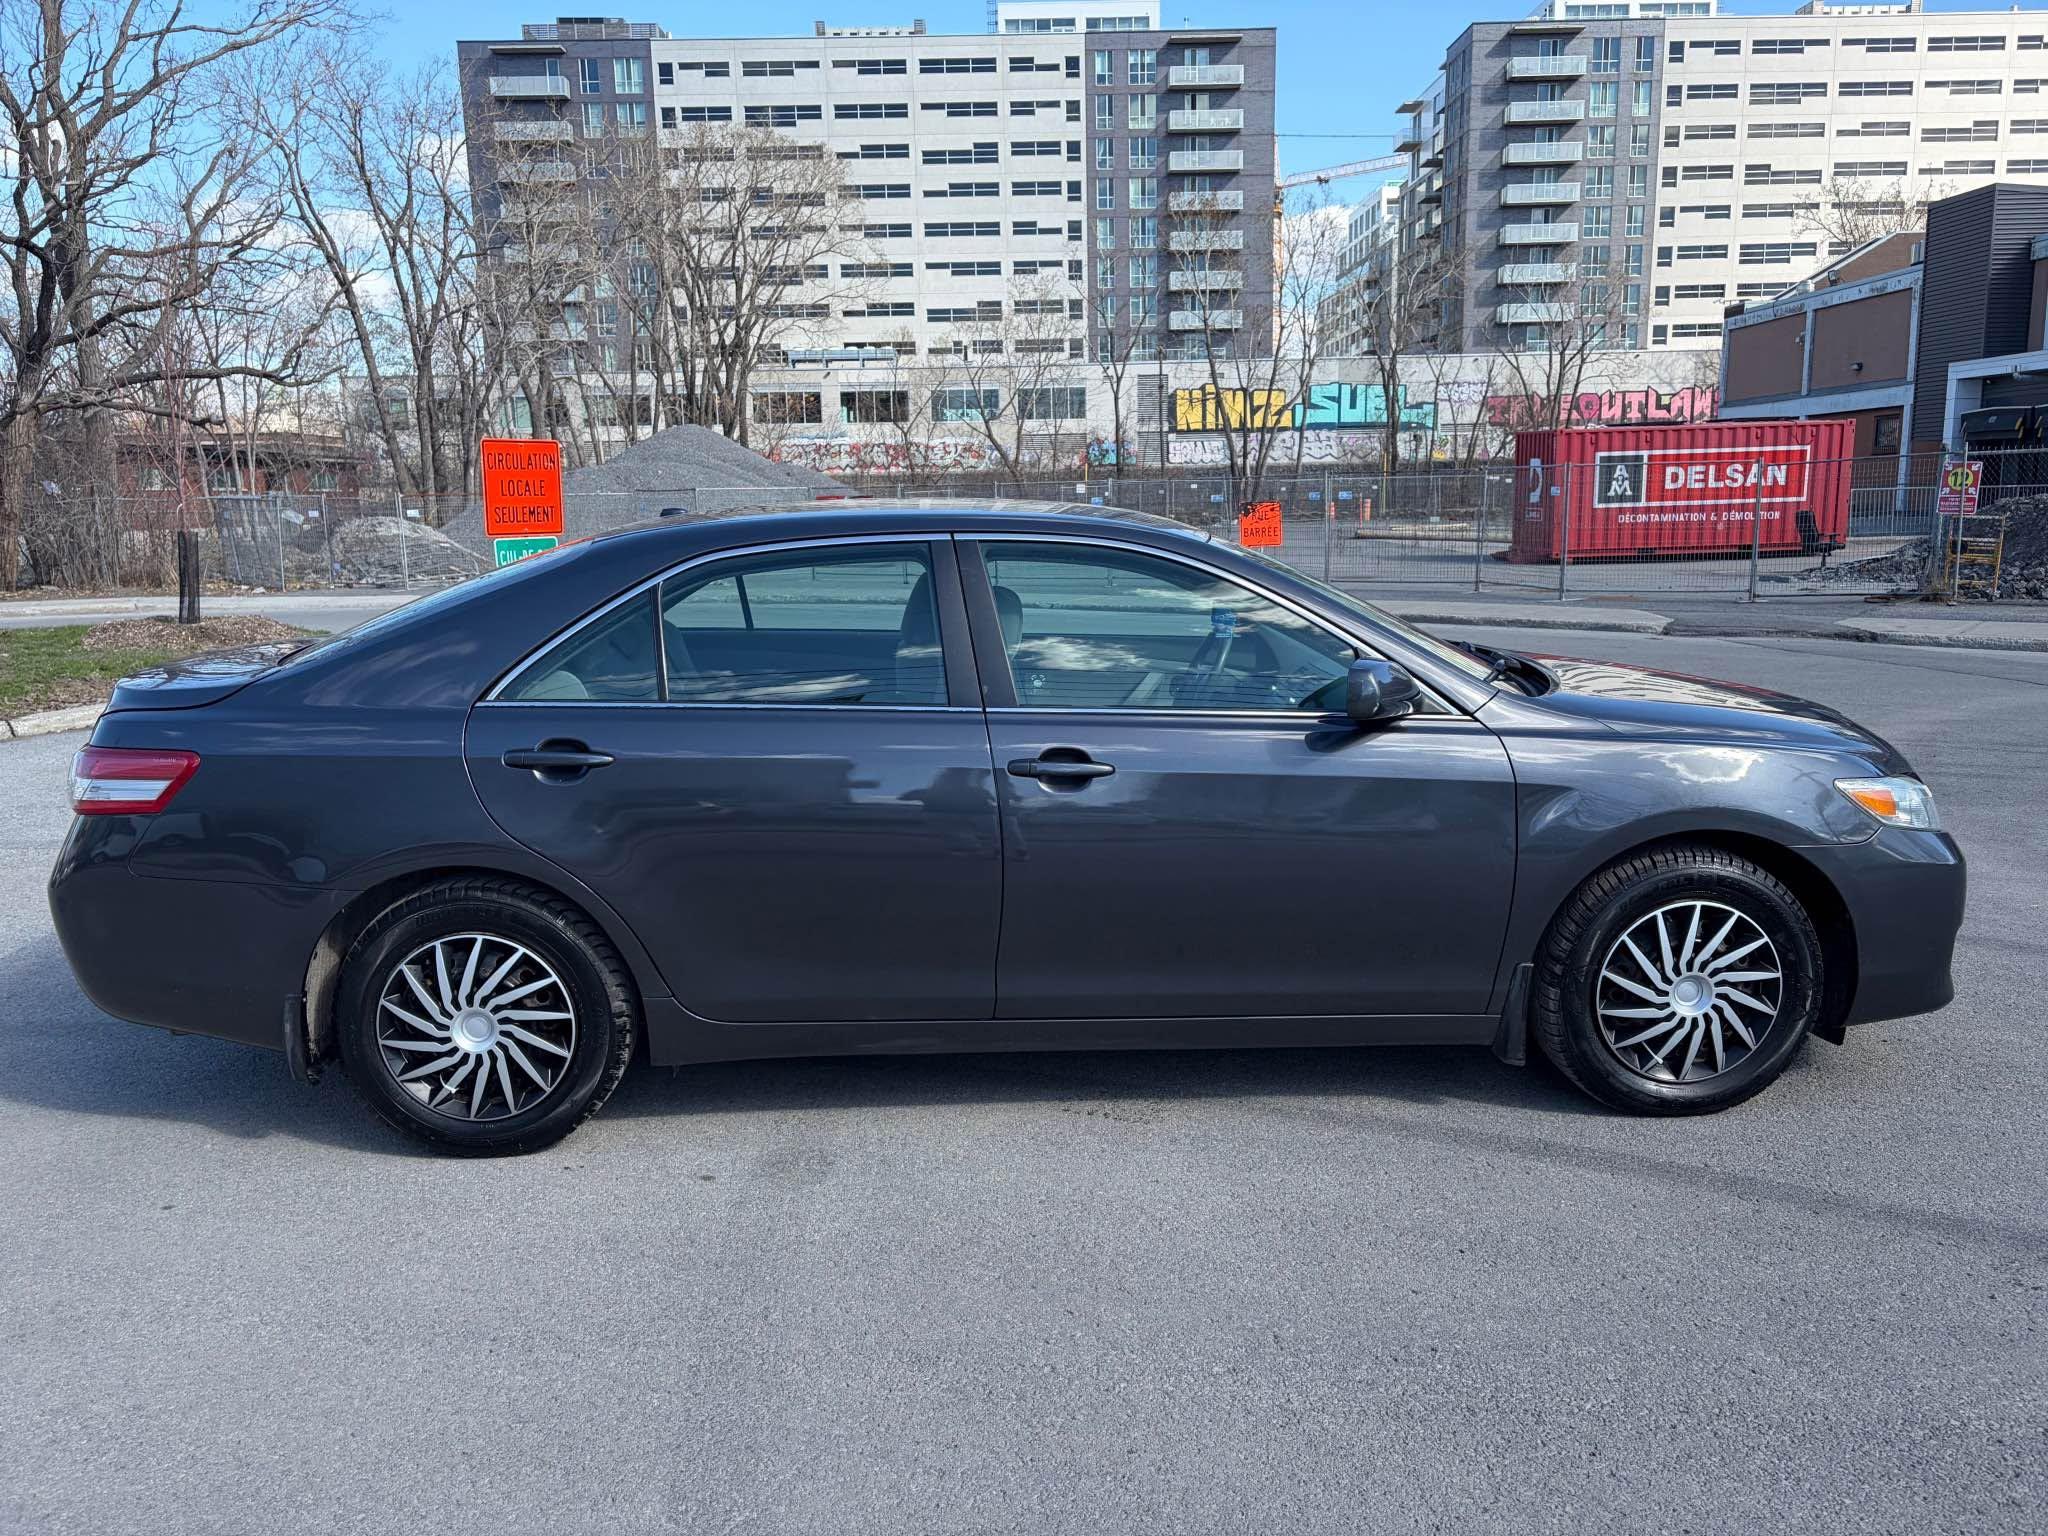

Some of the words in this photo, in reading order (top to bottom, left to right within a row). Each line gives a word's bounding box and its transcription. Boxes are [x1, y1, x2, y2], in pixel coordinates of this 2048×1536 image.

[486, 452, 556, 470] CIRCULATION
[1664, 463, 1788, 489] DELSAN
[500, 480, 546, 497] LOCALE
[494, 506, 555, 523] SEULEMENT
[1251, 510, 1269, 520] RUE
[1618, 511, 1706, 523] DÉCONTAMINATION
[1710, 512, 1718, 521] &
[1722, 510, 1781, 521] DÉMOLTION
[1243, 525, 1279, 538] BARRÉE
